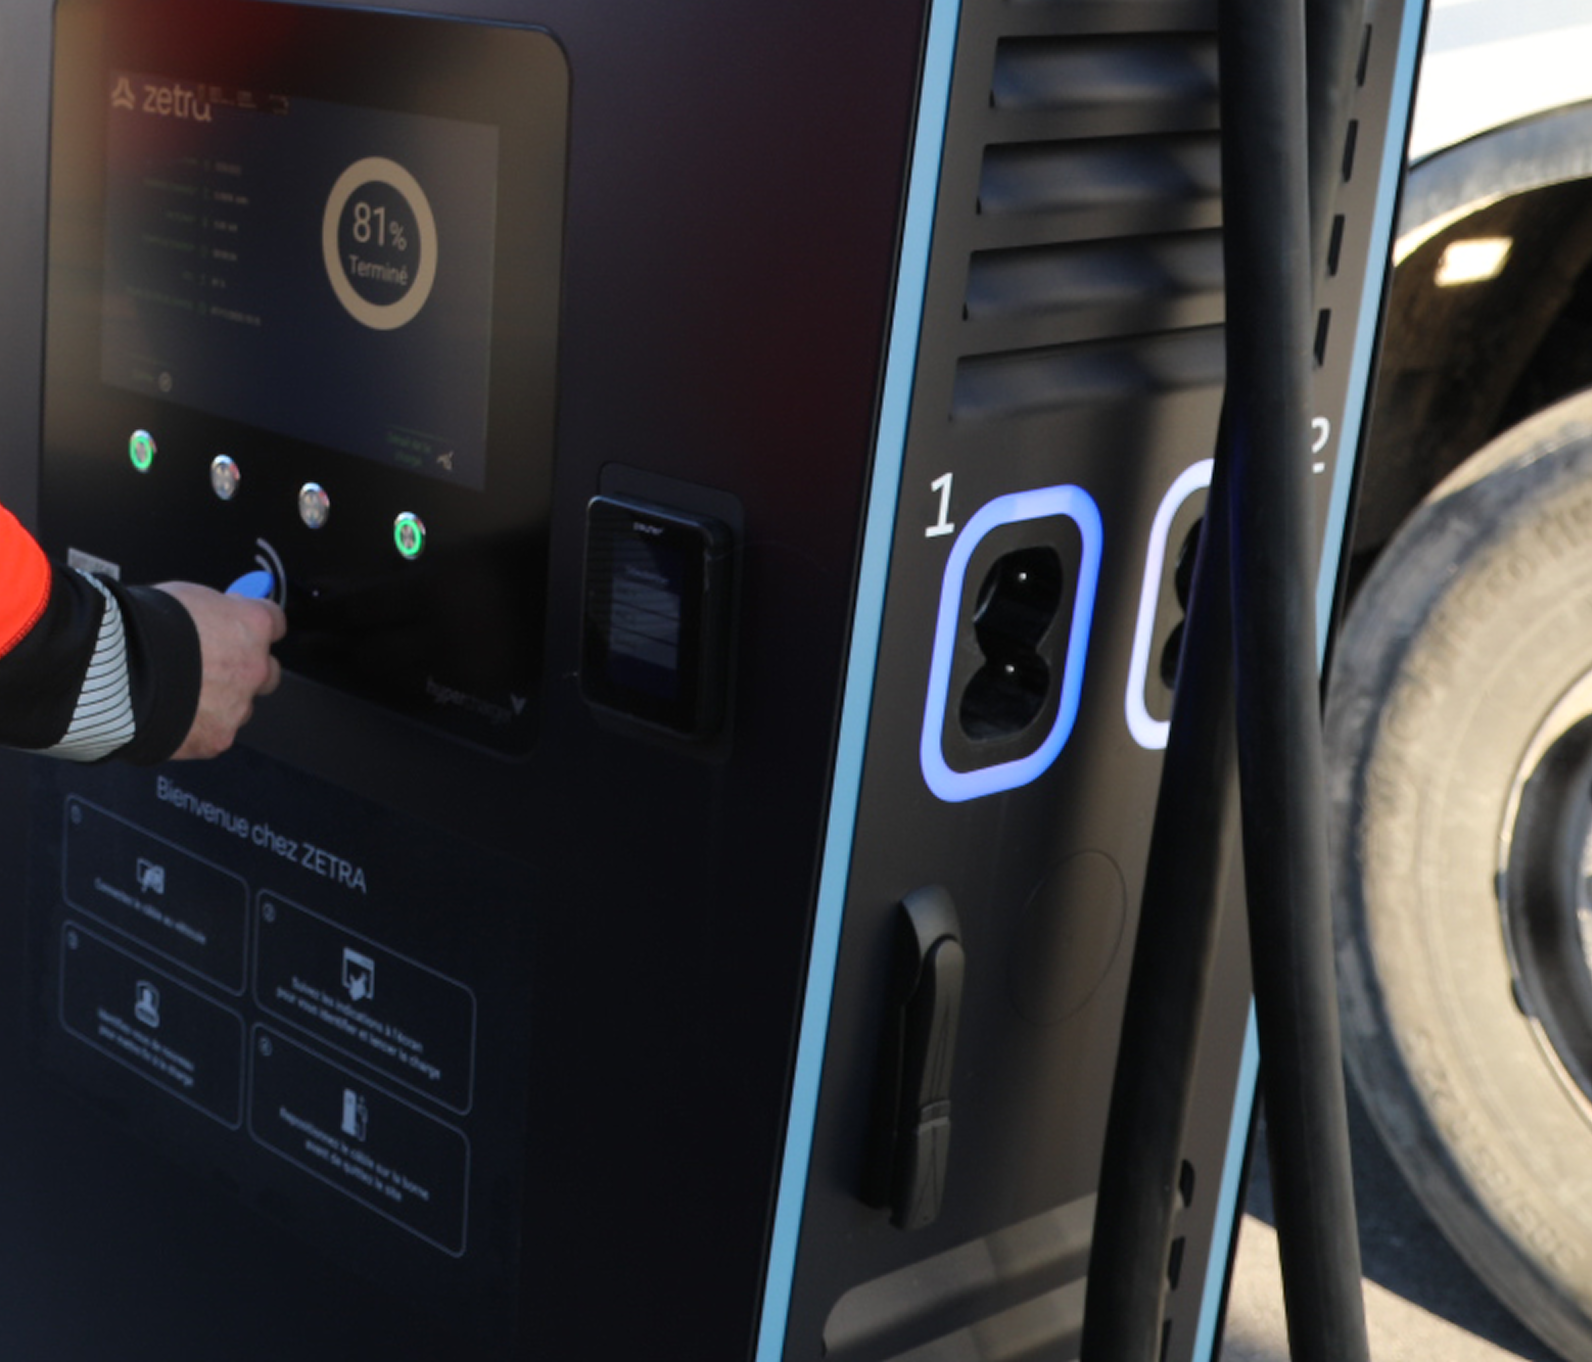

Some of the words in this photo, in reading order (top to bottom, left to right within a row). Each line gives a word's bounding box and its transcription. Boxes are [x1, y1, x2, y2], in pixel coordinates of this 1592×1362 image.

[352, 201, 407, 251] 81%
[348, 254, 408, 286] Terminé
[924, 472, 955, 537] 1
[156, 775, 250, 838] Bienvenue
[251, 822, 297, 862] chez
[301, 842, 367, 894] ZETRA
